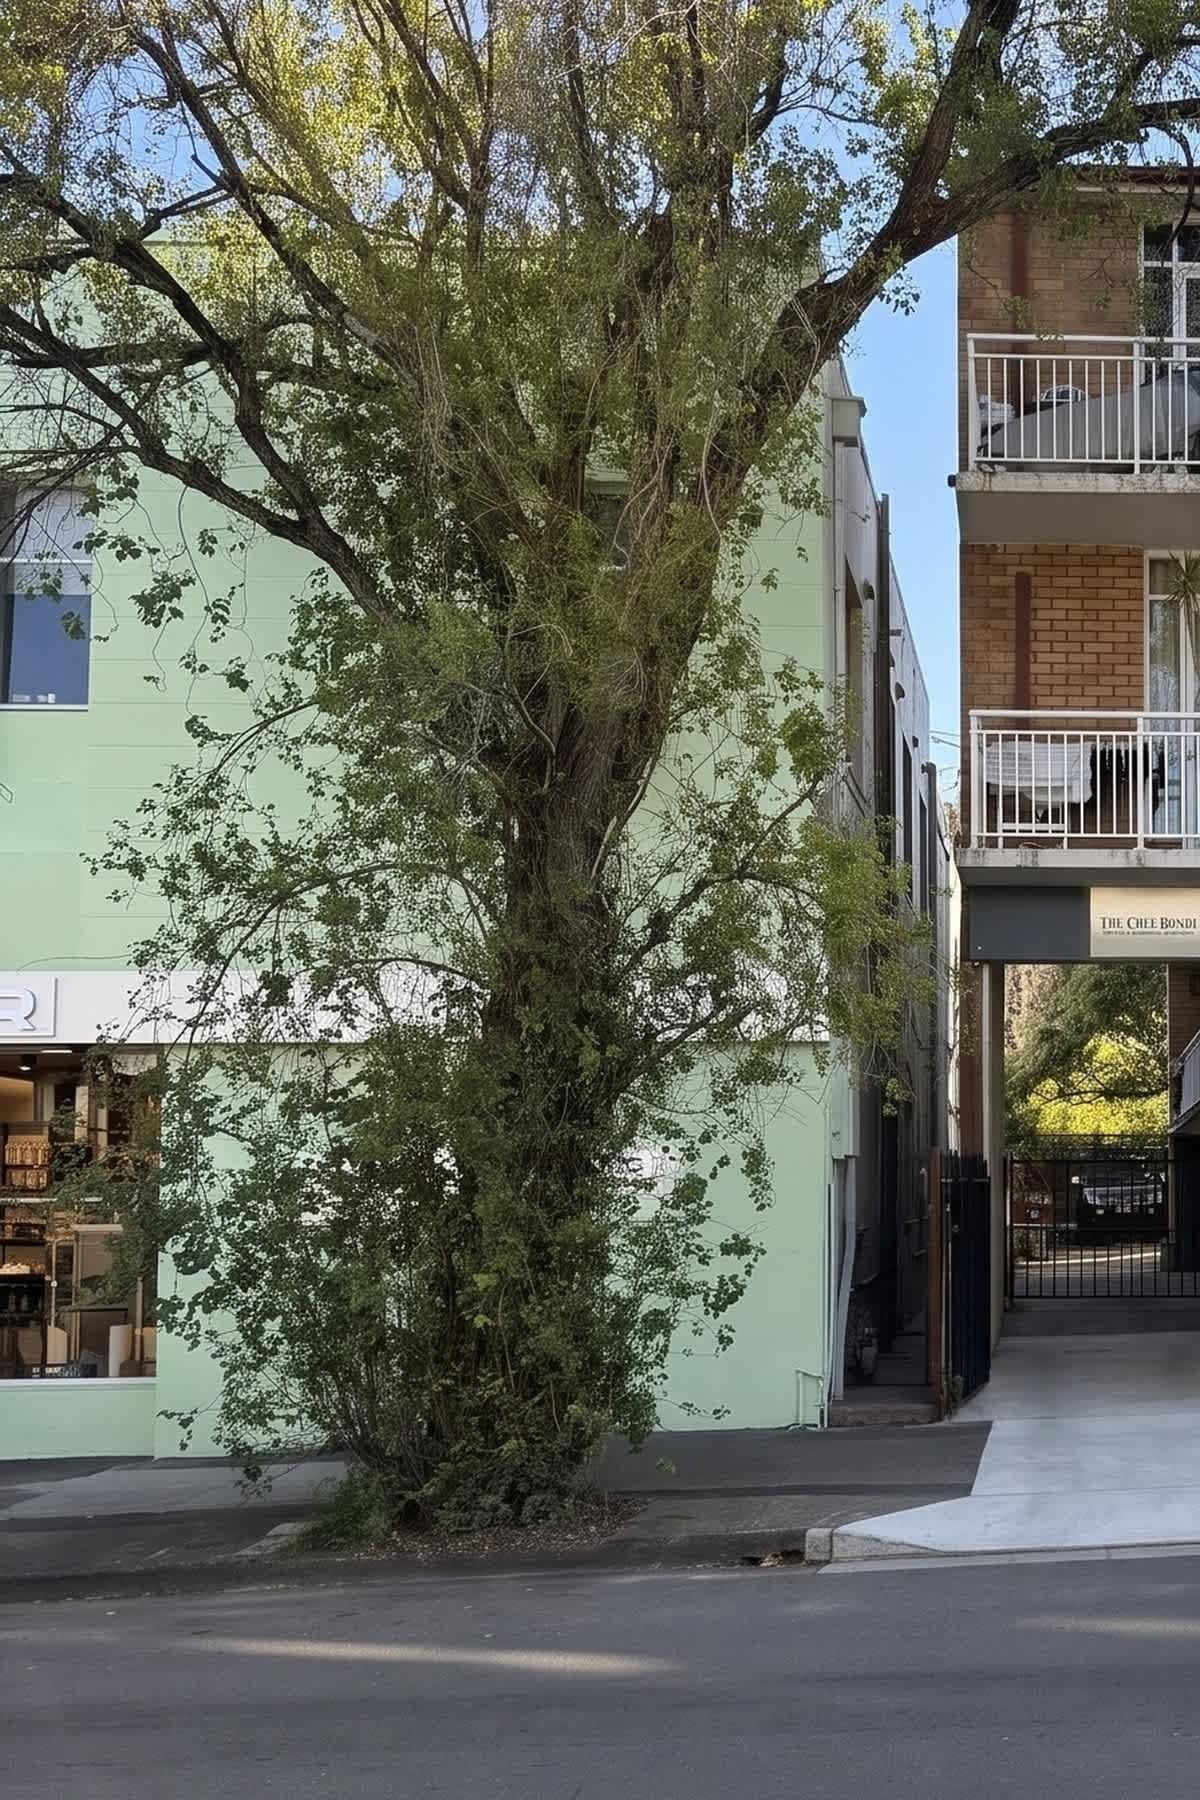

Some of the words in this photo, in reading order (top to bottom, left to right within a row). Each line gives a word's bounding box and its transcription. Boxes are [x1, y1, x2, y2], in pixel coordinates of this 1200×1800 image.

[1100, 917, 1123, 929] THE
[1127, 917, 1157, 929] CHEE
[1160, 917, 1197, 929] BONDI
